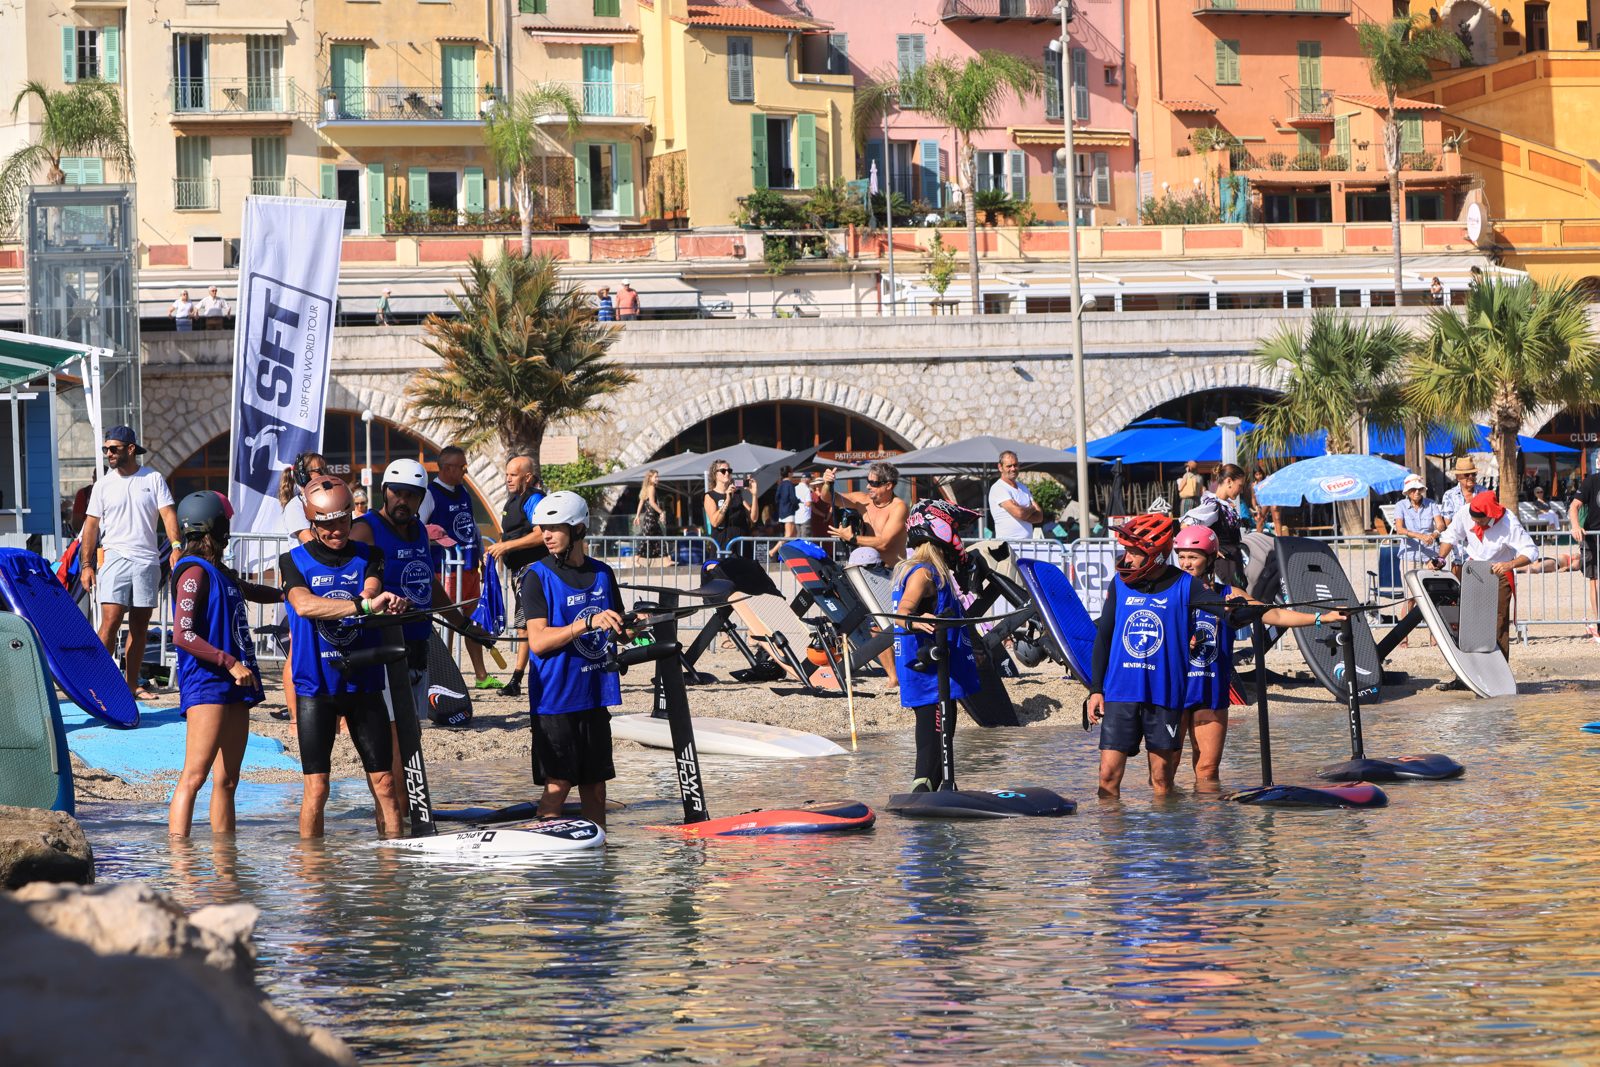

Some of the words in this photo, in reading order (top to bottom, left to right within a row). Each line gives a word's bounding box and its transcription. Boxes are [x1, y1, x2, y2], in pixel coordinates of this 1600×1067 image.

[308, 304, 319, 334] TOUR
[256, 287, 300, 408] SFT
[305, 335, 316, 370] WORLD
[303, 369, 312, 394] FOIL
[300, 393, 310, 419] SURF
[1570, 432, 1597, 442] CLUB
[1326, 479, 1355, 492] Frisco
[404, 766, 418, 811] FOIL
[677, 758, 691, 801] FOIL
